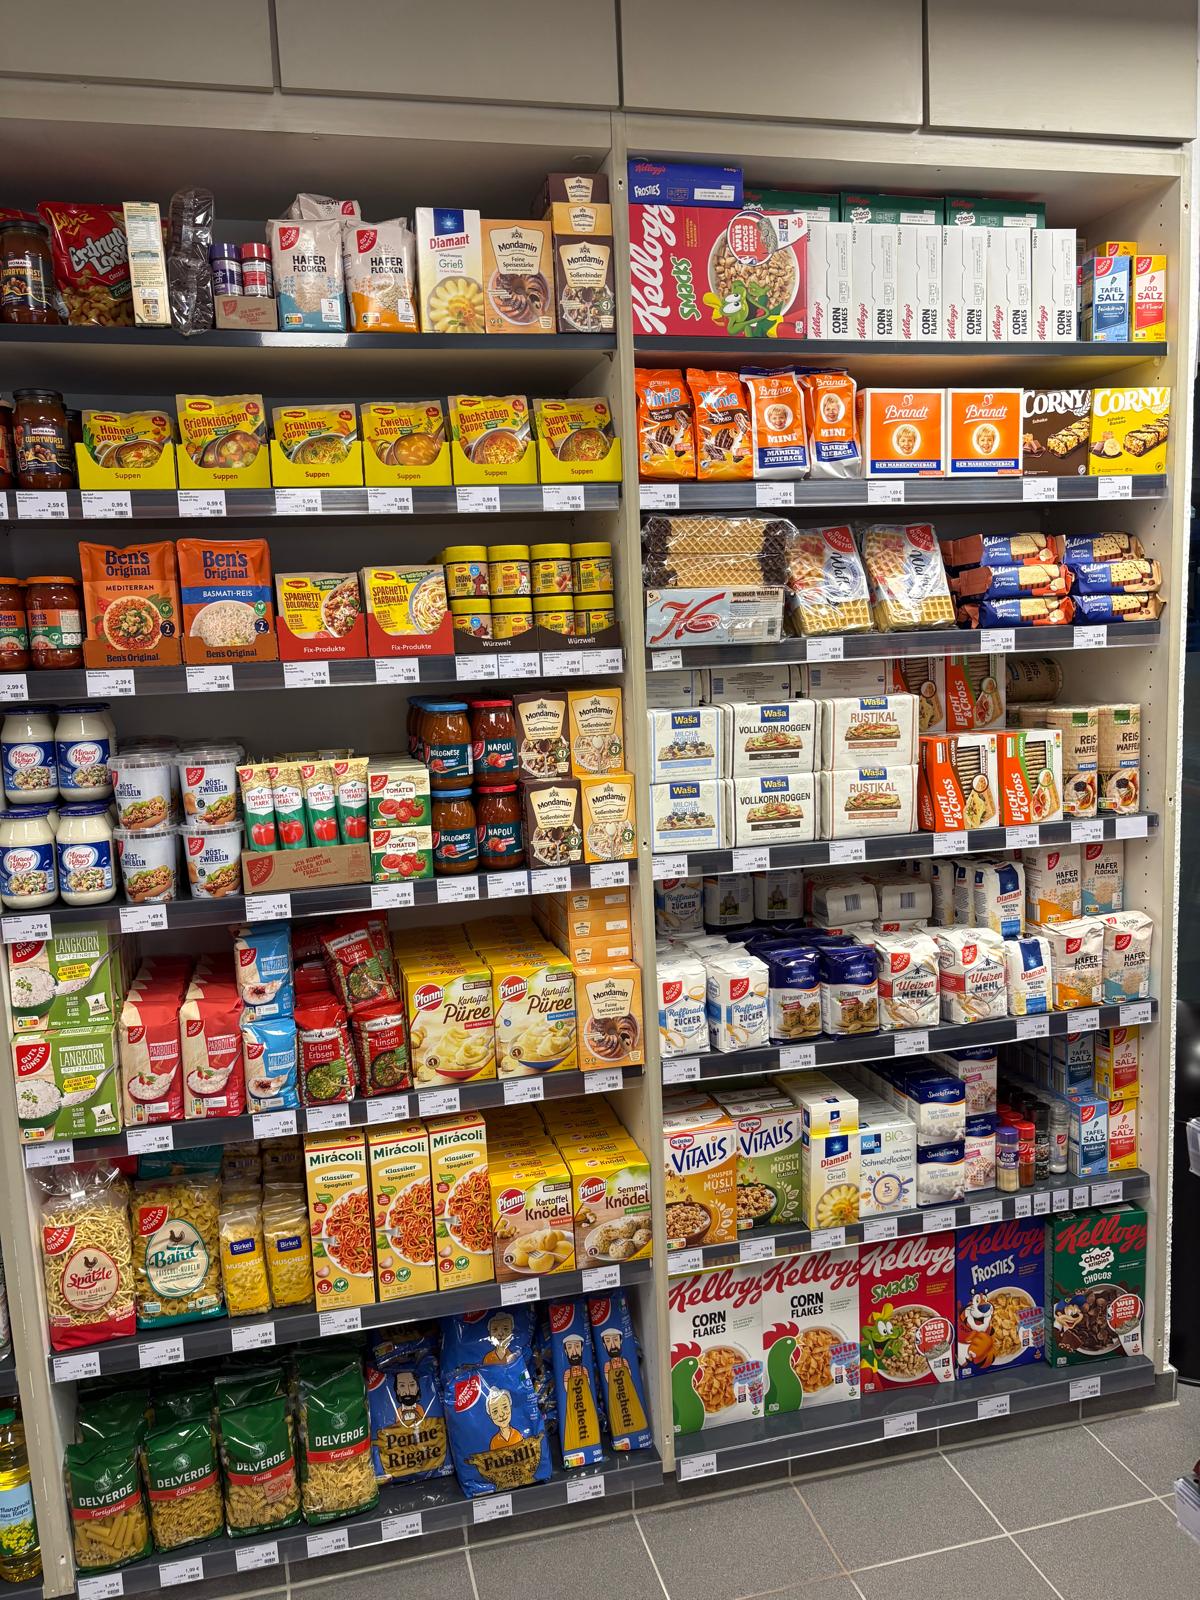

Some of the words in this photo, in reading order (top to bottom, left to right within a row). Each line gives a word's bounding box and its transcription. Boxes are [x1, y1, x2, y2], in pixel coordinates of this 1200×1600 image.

[634, 184, 661, 198] FROSTIES
[429, 234, 470, 250] Diamant
[497, 242, 538, 254] Mondamin
[292, 256, 326, 266] HAFER
[370, 257, 403, 267] HAFER
[438, 257, 464, 271] Grieß
[293, 265, 327, 274] FLOCKEN
[371, 266, 404, 274] FLOCKEN
[672, 257, 701, 324] Smacks
[1100, 286, 1123, 294] TAFEL
[1098, 293, 1125, 302] SALZ
[1136, 292, 1163, 301] SALZ
[832, 307, 842, 334] CORN
[1092, 388, 1164, 418] CORNY
[458, 408, 510, 425] Buchstaben
[885, 406, 929, 420] Brandt
[183, 412, 249, 430] Grießklößchen
[378, 416, 413, 428] Zwiebel
[544, 416, 569, 428] Suppe
[100, 426, 135, 438] Hühner
[548, 424, 568, 438] Rind
[25, 436, 64, 445] CURRYWURST
[766, 433, 798, 443] MINI
[115, 472, 142, 480] Suppen
[212, 472, 239, 482] Suppen
[304, 470, 330, 480] Suppen
[396, 472, 422, 482] Suppen
[105, 550, 150, 566] Ben's
[202, 550, 248, 568] Ben's
[106, 565, 151, 579] Original
[204, 567, 248, 580] Original
[106, 584, 154, 592] MEDITERRAN
[202, 589, 253, 598] BASMATI-REIS
[372, 585, 409, 597] SPAGHETTI
[482, 639, 512, 648] Würzwelt
[567, 636, 596, 645] Würzwelt
[303, 644, 345, 655] Fix-Produkte
[390, 642, 432, 653] Fix-Produkte
[106, 653, 128, 663] Ben's
[129, 652, 160, 663] Original
[524, 711, 560, 722] Mondamin
[578, 707, 614, 718] Mondamin
[850, 712, 898, 724] RUSTIKAL
[674, 715, 698, 726] Wasa
[738, 725, 779, 735] VOLLKORN
[780, 724, 812, 734] ROGGEN
[1080, 734, 1098, 746] REIS-
[486, 742, 512, 753] NAPOLI
[12, 750, 38, 761] Miracel
[430, 749, 460, 759] BOLOGNESE
[14, 757, 33, 766] Whip
[205, 778, 224, 788] RÖST-
[849, 782, 898, 794] RUSTIKAL
[198, 784, 228, 795] ZWIEBELN
[385, 786, 414, 796] TOMATEN
[740, 796, 780, 806] VOLLKORN
[780, 792, 812, 803] ROGGEN
[936, 792, 958, 829] LEICHT
[488, 826, 512, 838] NAPOLI
[388, 841, 416, 850] TOMATEN
[440, 834, 472, 845] BOLOGNESE
[200, 854, 230, 864] ZWIEBELN
[996, 890, 1023, 904] Diamant
[54, 935, 100, 954] LANGKORN
[342, 942, 364, 956] Teller
[970, 971, 1003, 985] Weizen
[1020, 968, 1048, 983] Diamant
[974, 982, 999, 994] MEHL
[839, 990, 859, 1000] Brauner
[902, 990, 930, 1001] MEHL
[458, 994, 489, 1010] Kartoffel
[526, 997, 574, 1018] Püree
[442, 1005, 491, 1026] Püree
[674, 1016, 702, 1028] ZUCKER
[374, 1036, 400, 1048] Linsen
[150, 1044, 179, 1058] PARBOILED
[308, 1044, 333, 1054] Grüne
[59, 1048, 106, 1067] LANGKORN
[308, 1050, 336, 1061] Erbsen
[432, 1130, 484, 1149] Mirácoli
[740, 1118, 795, 1156] VITALIS
[862, 1140, 880, 1150] Kölln
[373, 1142, 426, 1161] Mirácoli
[309, 1150, 364, 1168] Mirácoli
[861, 1154, 914, 1170] Schmelzflocken
[384, 1164, 417, 1176] Klassiker
[770, 1160, 800, 1175] MÜSLI
[321, 1173, 354, 1184] Klassiker
[617, 1182, 649, 1196] Semmel
[703, 1178, 734, 1193] MÜSLI
[534, 1195, 569, 1208] Kartoffel
[604, 1193, 650, 1212] Knödel
[524, 1204, 572, 1222] Knödel
[232, 1241, 252, 1252] Birkel
[971, 1254, 1016, 1286] FROSTIES
[66, 1268, 114, 1290] Spätzle
[1083, 1272, 1113, 1287] CHOCOS
[790, 1292, 825, 1310] CORN
[790, 1306, 824, 1320] FLAKES
[692, 1310, 727, 1329] CORN
[692, 1325, 727, 1340] FLAKES
[924, 1328, 945, 1339] crocs
[614, 1368, 633, 1428] Spaghetti
[573, 1377, 591, 1441] Spaghetti
[314, 1425, 366, 1450] DELVERDE
[386, 1425, 438, 1451] Penne
[236, 1450, 286, 1473] DELVERDE
[329, 1450, 355, 1462] Farfalle
[387, 1446, 442, 1474] Rigate
[483, 1447, 538, 1474] Fusilli
[157, 1464, 212, 1489] DELVERDE
[79, 1484, 134, 1508] DELVERDE
[176, 1486, 197, 1498] Eliche
[11, 1508, 30, 1519] Raps
[90, 1502, 126, 1518] Tortiglioni
